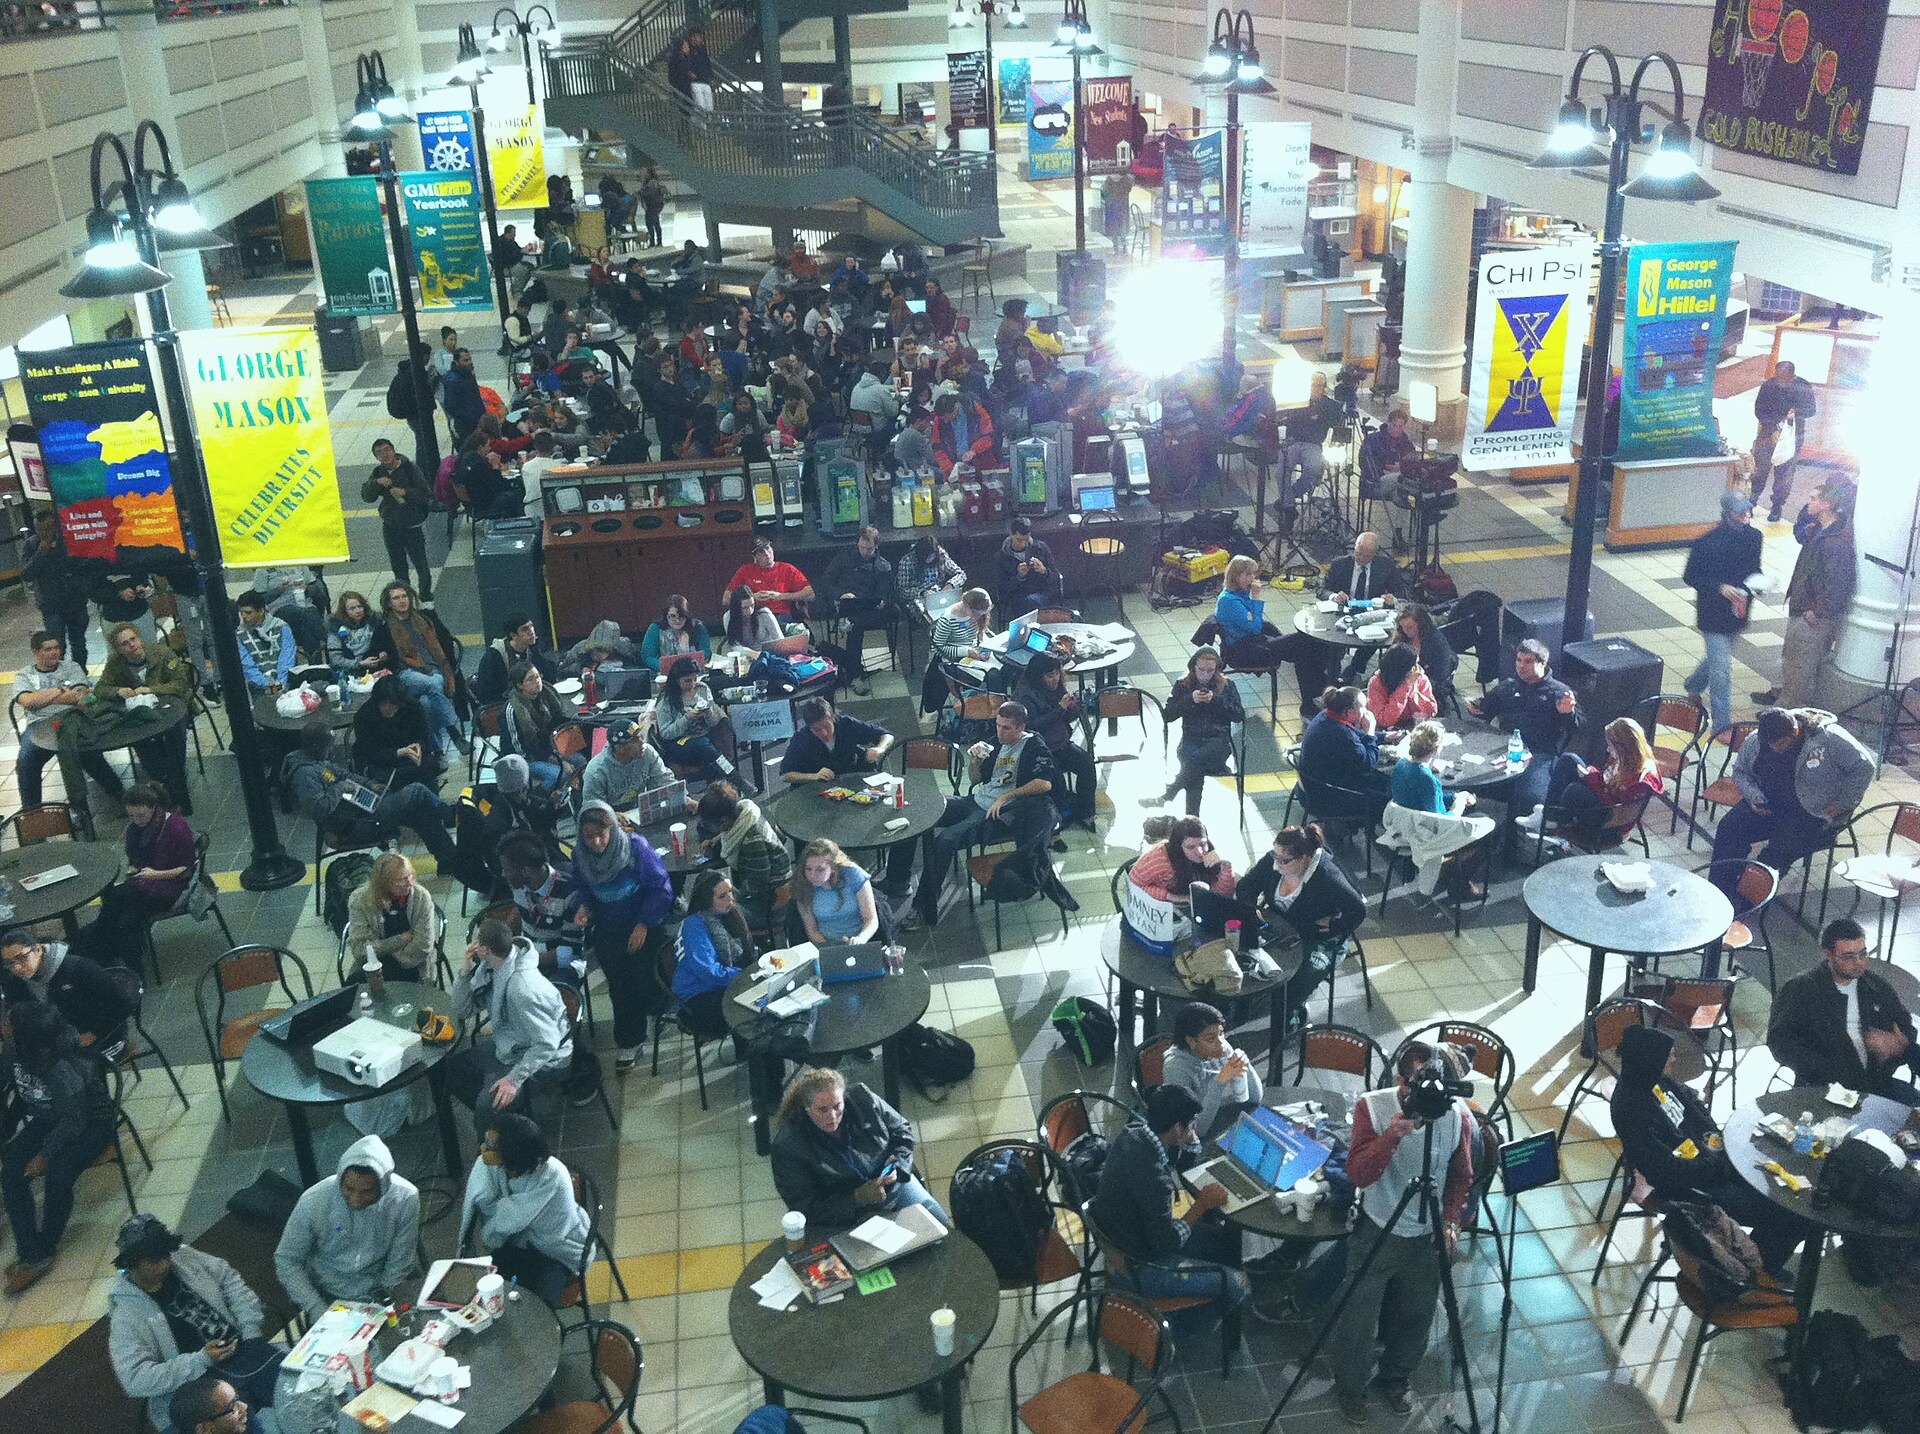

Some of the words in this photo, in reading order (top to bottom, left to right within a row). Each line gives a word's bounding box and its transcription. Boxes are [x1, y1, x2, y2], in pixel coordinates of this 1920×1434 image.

[1087, 82, 1130, 107] WELCOME
[1704, 108, 1742, 147] GOLD
[1744, 115, 1788, 158] RUSH
[495, 136, 534, 149] MASON
[1285, 144, 1308, 153] Don't
[1296, 158, 1308, 166] Let
[1264, 184, 1306, 193] Memories
[412, 197, 469, 210] Yearbook
[1666, 258, 1718, 272] George
[1666, 277, 1712, 290] Mason
[1658, 294, 1717, 315] Hillel
[27, 368, 54, 378] Make
[55, 363, 102, 376] Excellence
[104, 361, 112, 370] A
[112, 358, 140, 368] Habit
[198, 349, 311, 383] GEORGE
[81, 376, 93, 385] At
[35, 391, 68, 403] George
[69, 388, 99, 398] Mason
[101, 382, 146, 396] University
[213, 396, 312, 429] MASON
[1473, 431, 1564, 445] PROMOTING
[1470, 441, 1564, 456] GENTLEMEN
[117, 472, 145, 481] Dream
[146, 469, 161, 479] Big
[229, 447, 311, 537] CELEBRATES
[252, 465, 324, 546] DIVERSITY
[69, 512, 87, 521] Live
[88, 510, 103, 519] and
[66, 522, 91, 531] Learn
[91, 520, 109, 529] with
[74, 531, 108, 541] Integrity
[748, 718, 782, 728] OBAMA
